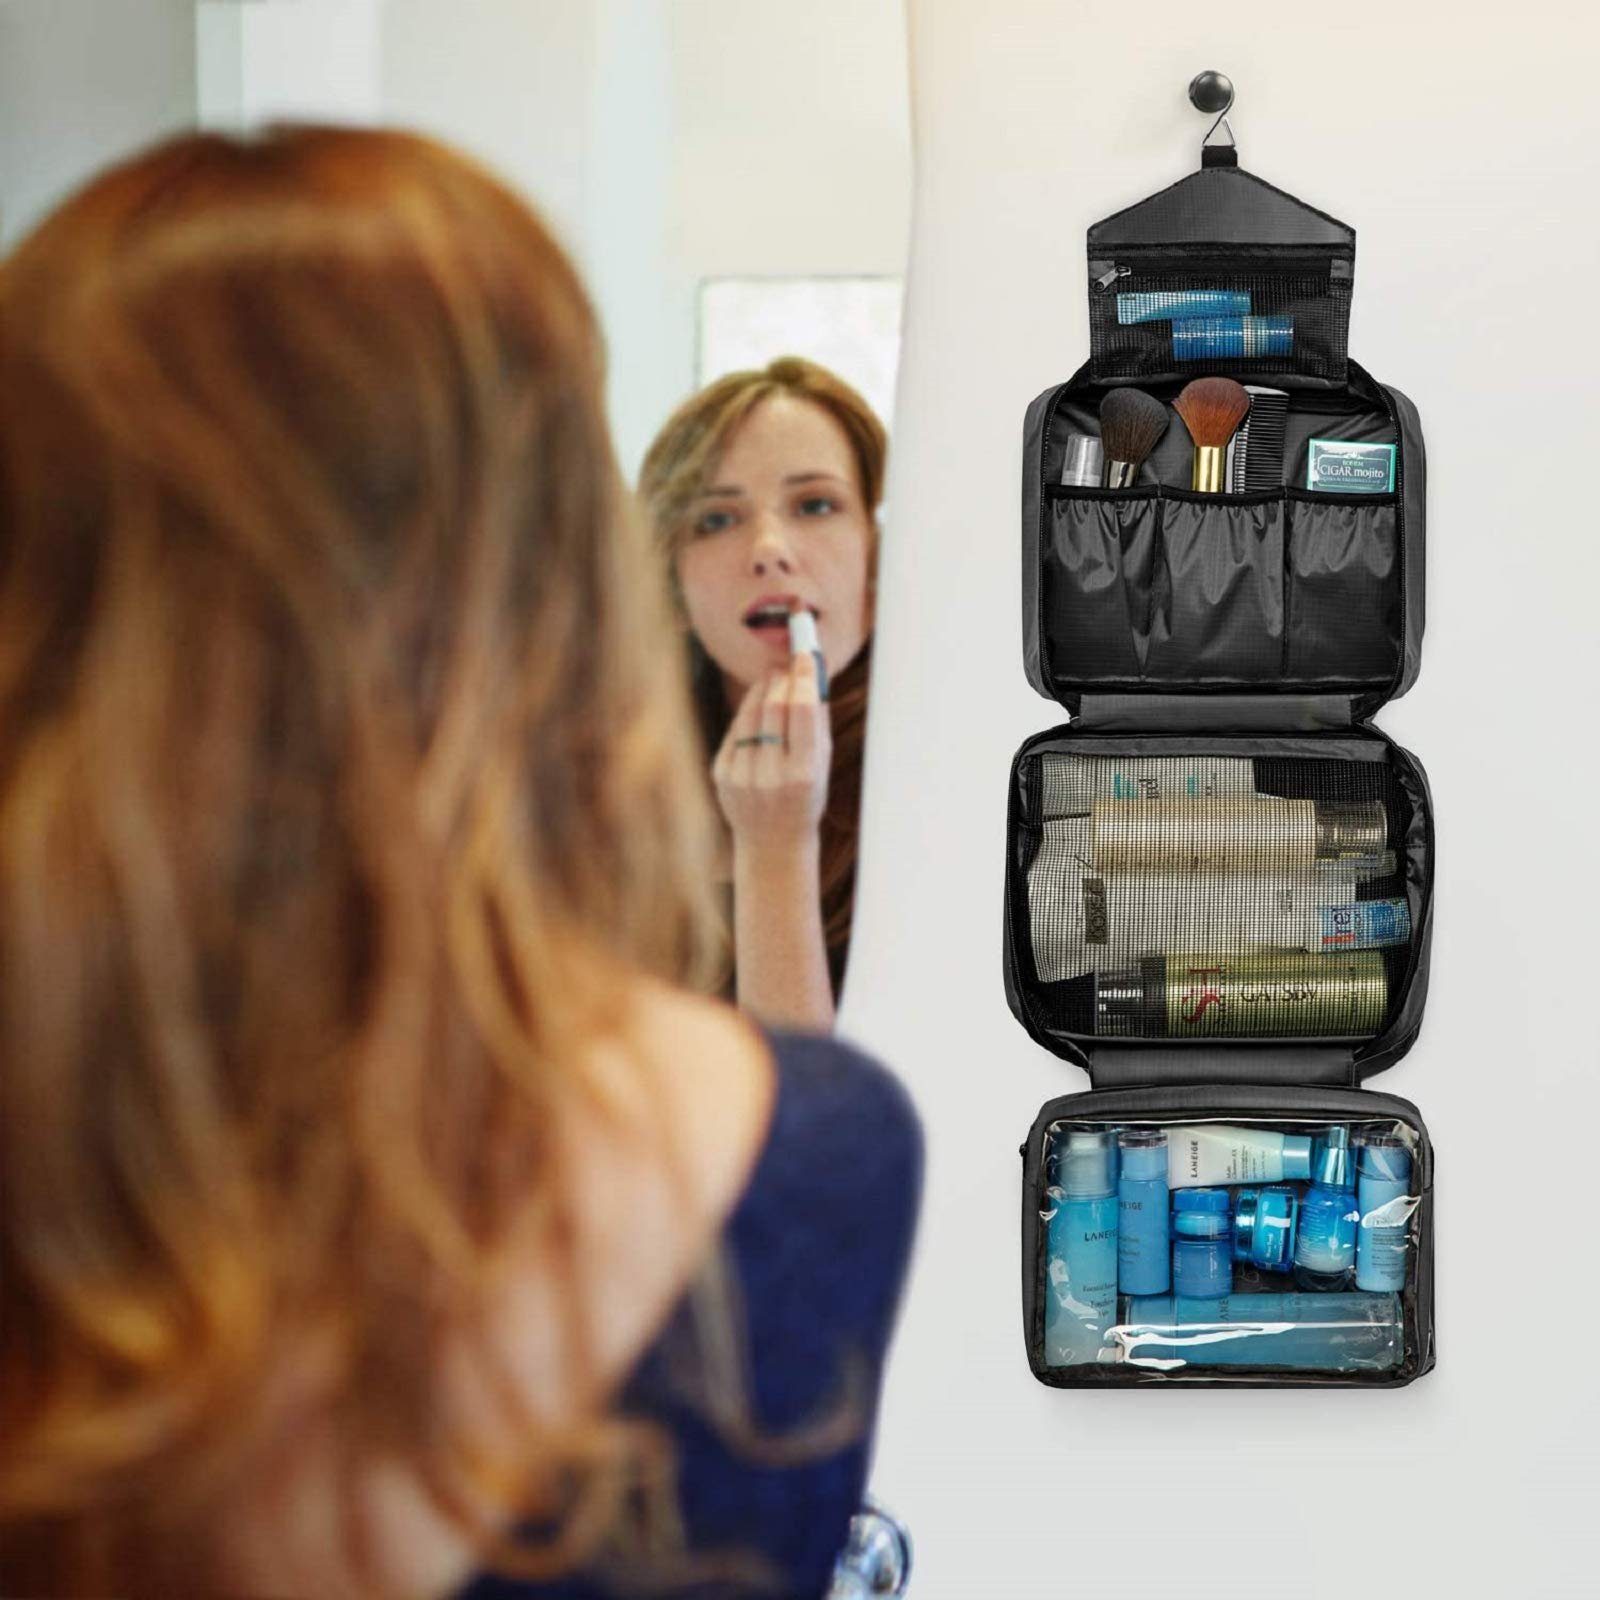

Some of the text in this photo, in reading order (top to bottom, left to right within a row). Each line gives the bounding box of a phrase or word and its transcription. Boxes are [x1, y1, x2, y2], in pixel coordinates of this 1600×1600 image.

[1320, 464, 1384, 478] CIGAR mojito
[1240, 982, 1317, 1002] GATSBY
[1190, 1140, 1199, 1179] LANEIGE
